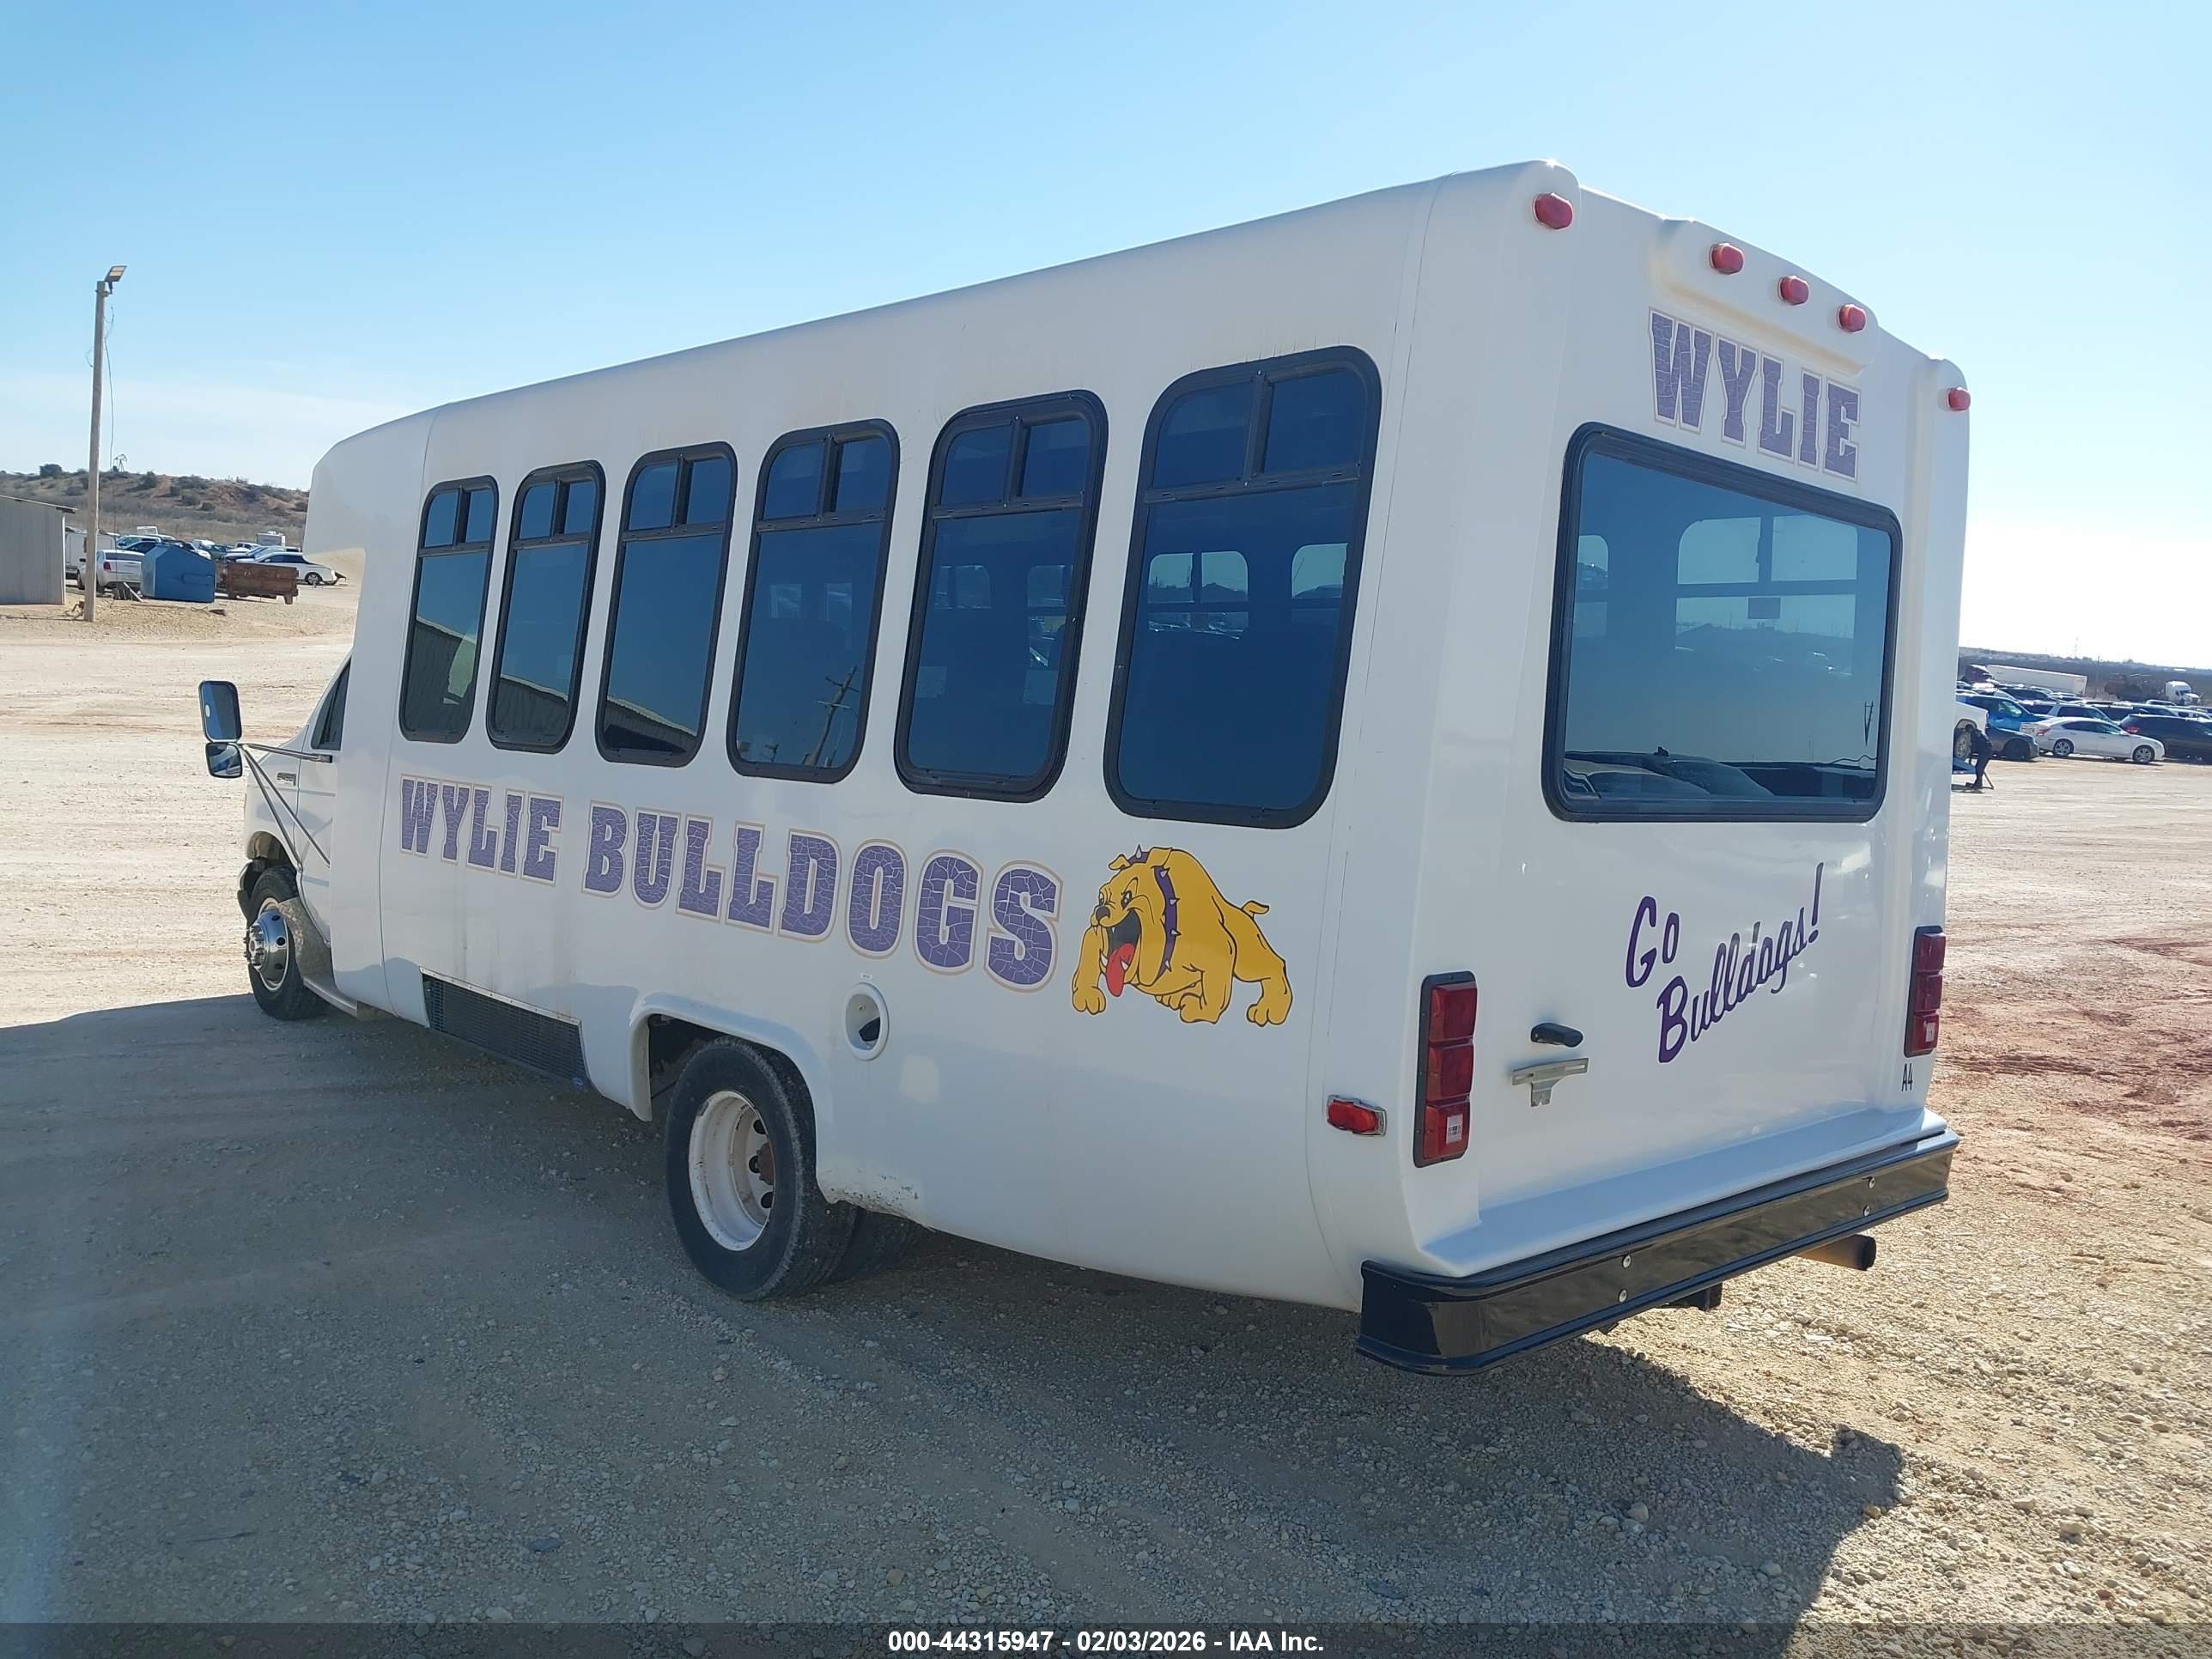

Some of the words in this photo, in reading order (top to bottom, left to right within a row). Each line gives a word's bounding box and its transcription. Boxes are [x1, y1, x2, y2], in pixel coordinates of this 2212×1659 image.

[1649, 306, 1861, 482] WYLIE
[400, 774, 564, 887] WYLIE
[580, 799, 1063, 993] BULLDOGS
[1626, 896, 1680, 988] Go
[1656, 861, 1824, 1064] Bulldogs!
[1900, 1062, 1913, 1092] A4
